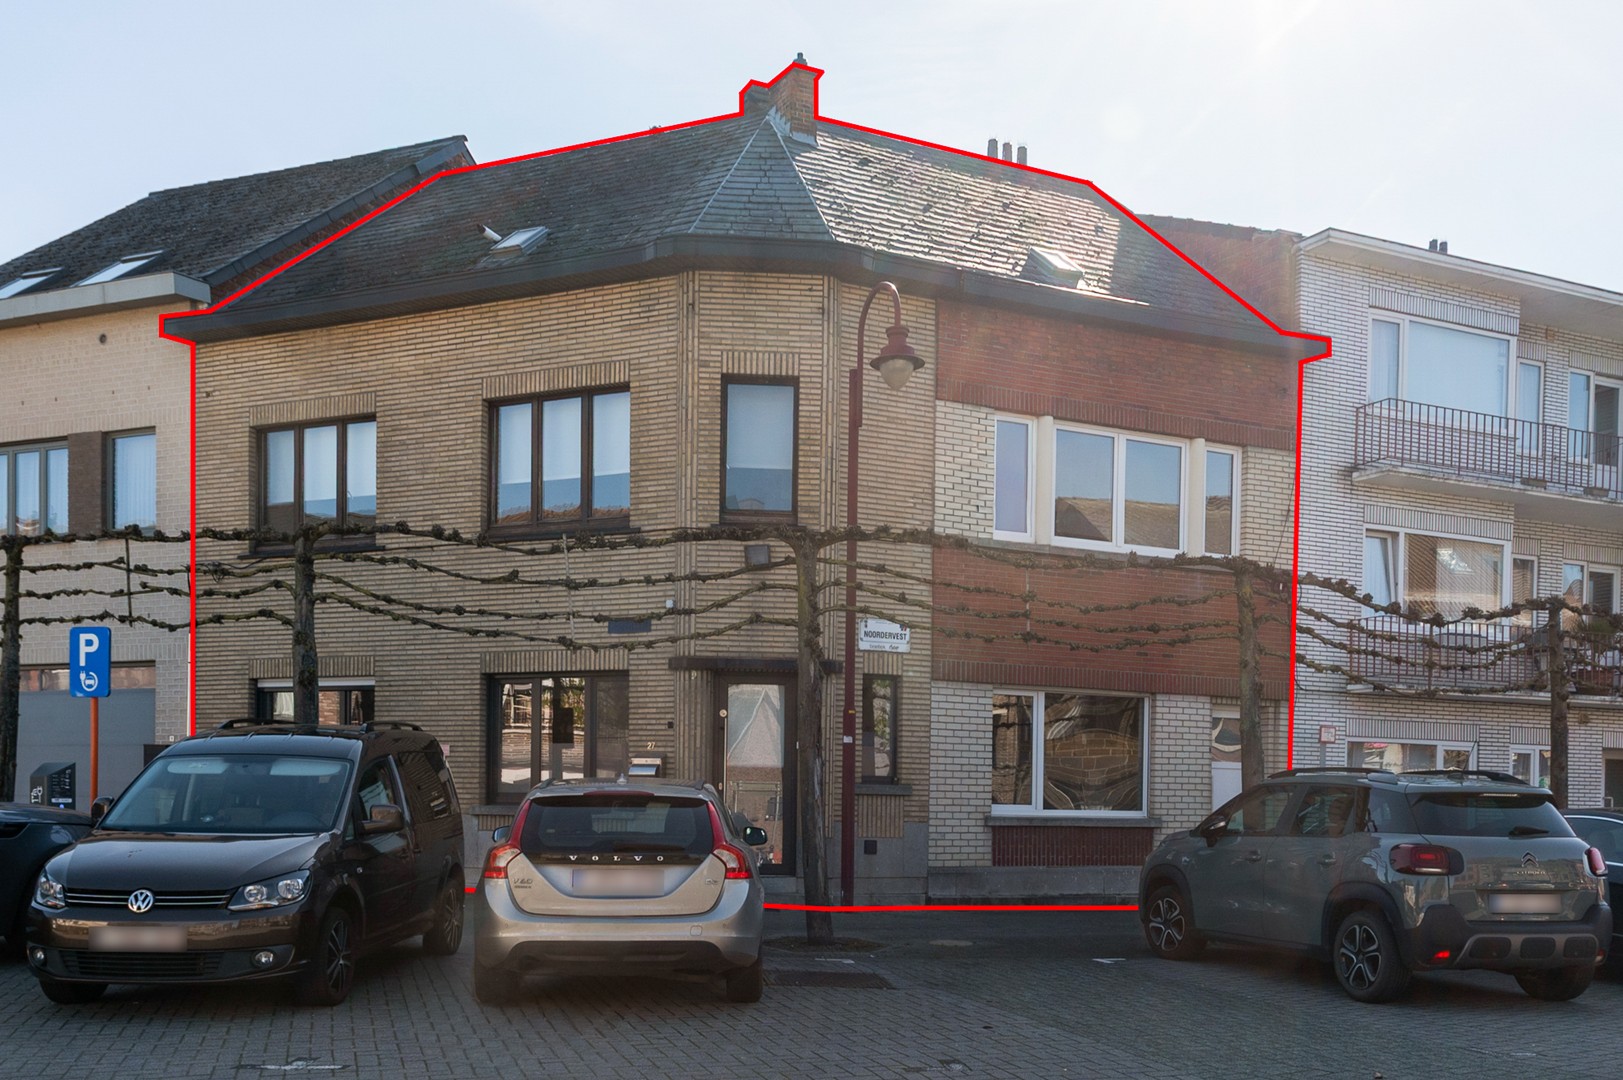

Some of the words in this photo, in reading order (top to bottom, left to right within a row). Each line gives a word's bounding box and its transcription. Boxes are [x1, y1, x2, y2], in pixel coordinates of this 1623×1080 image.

[864, 630, 907, 640] NOORDERVEST
[79, 633, 99, 667] P
[647, 742, 656, 750] 27
